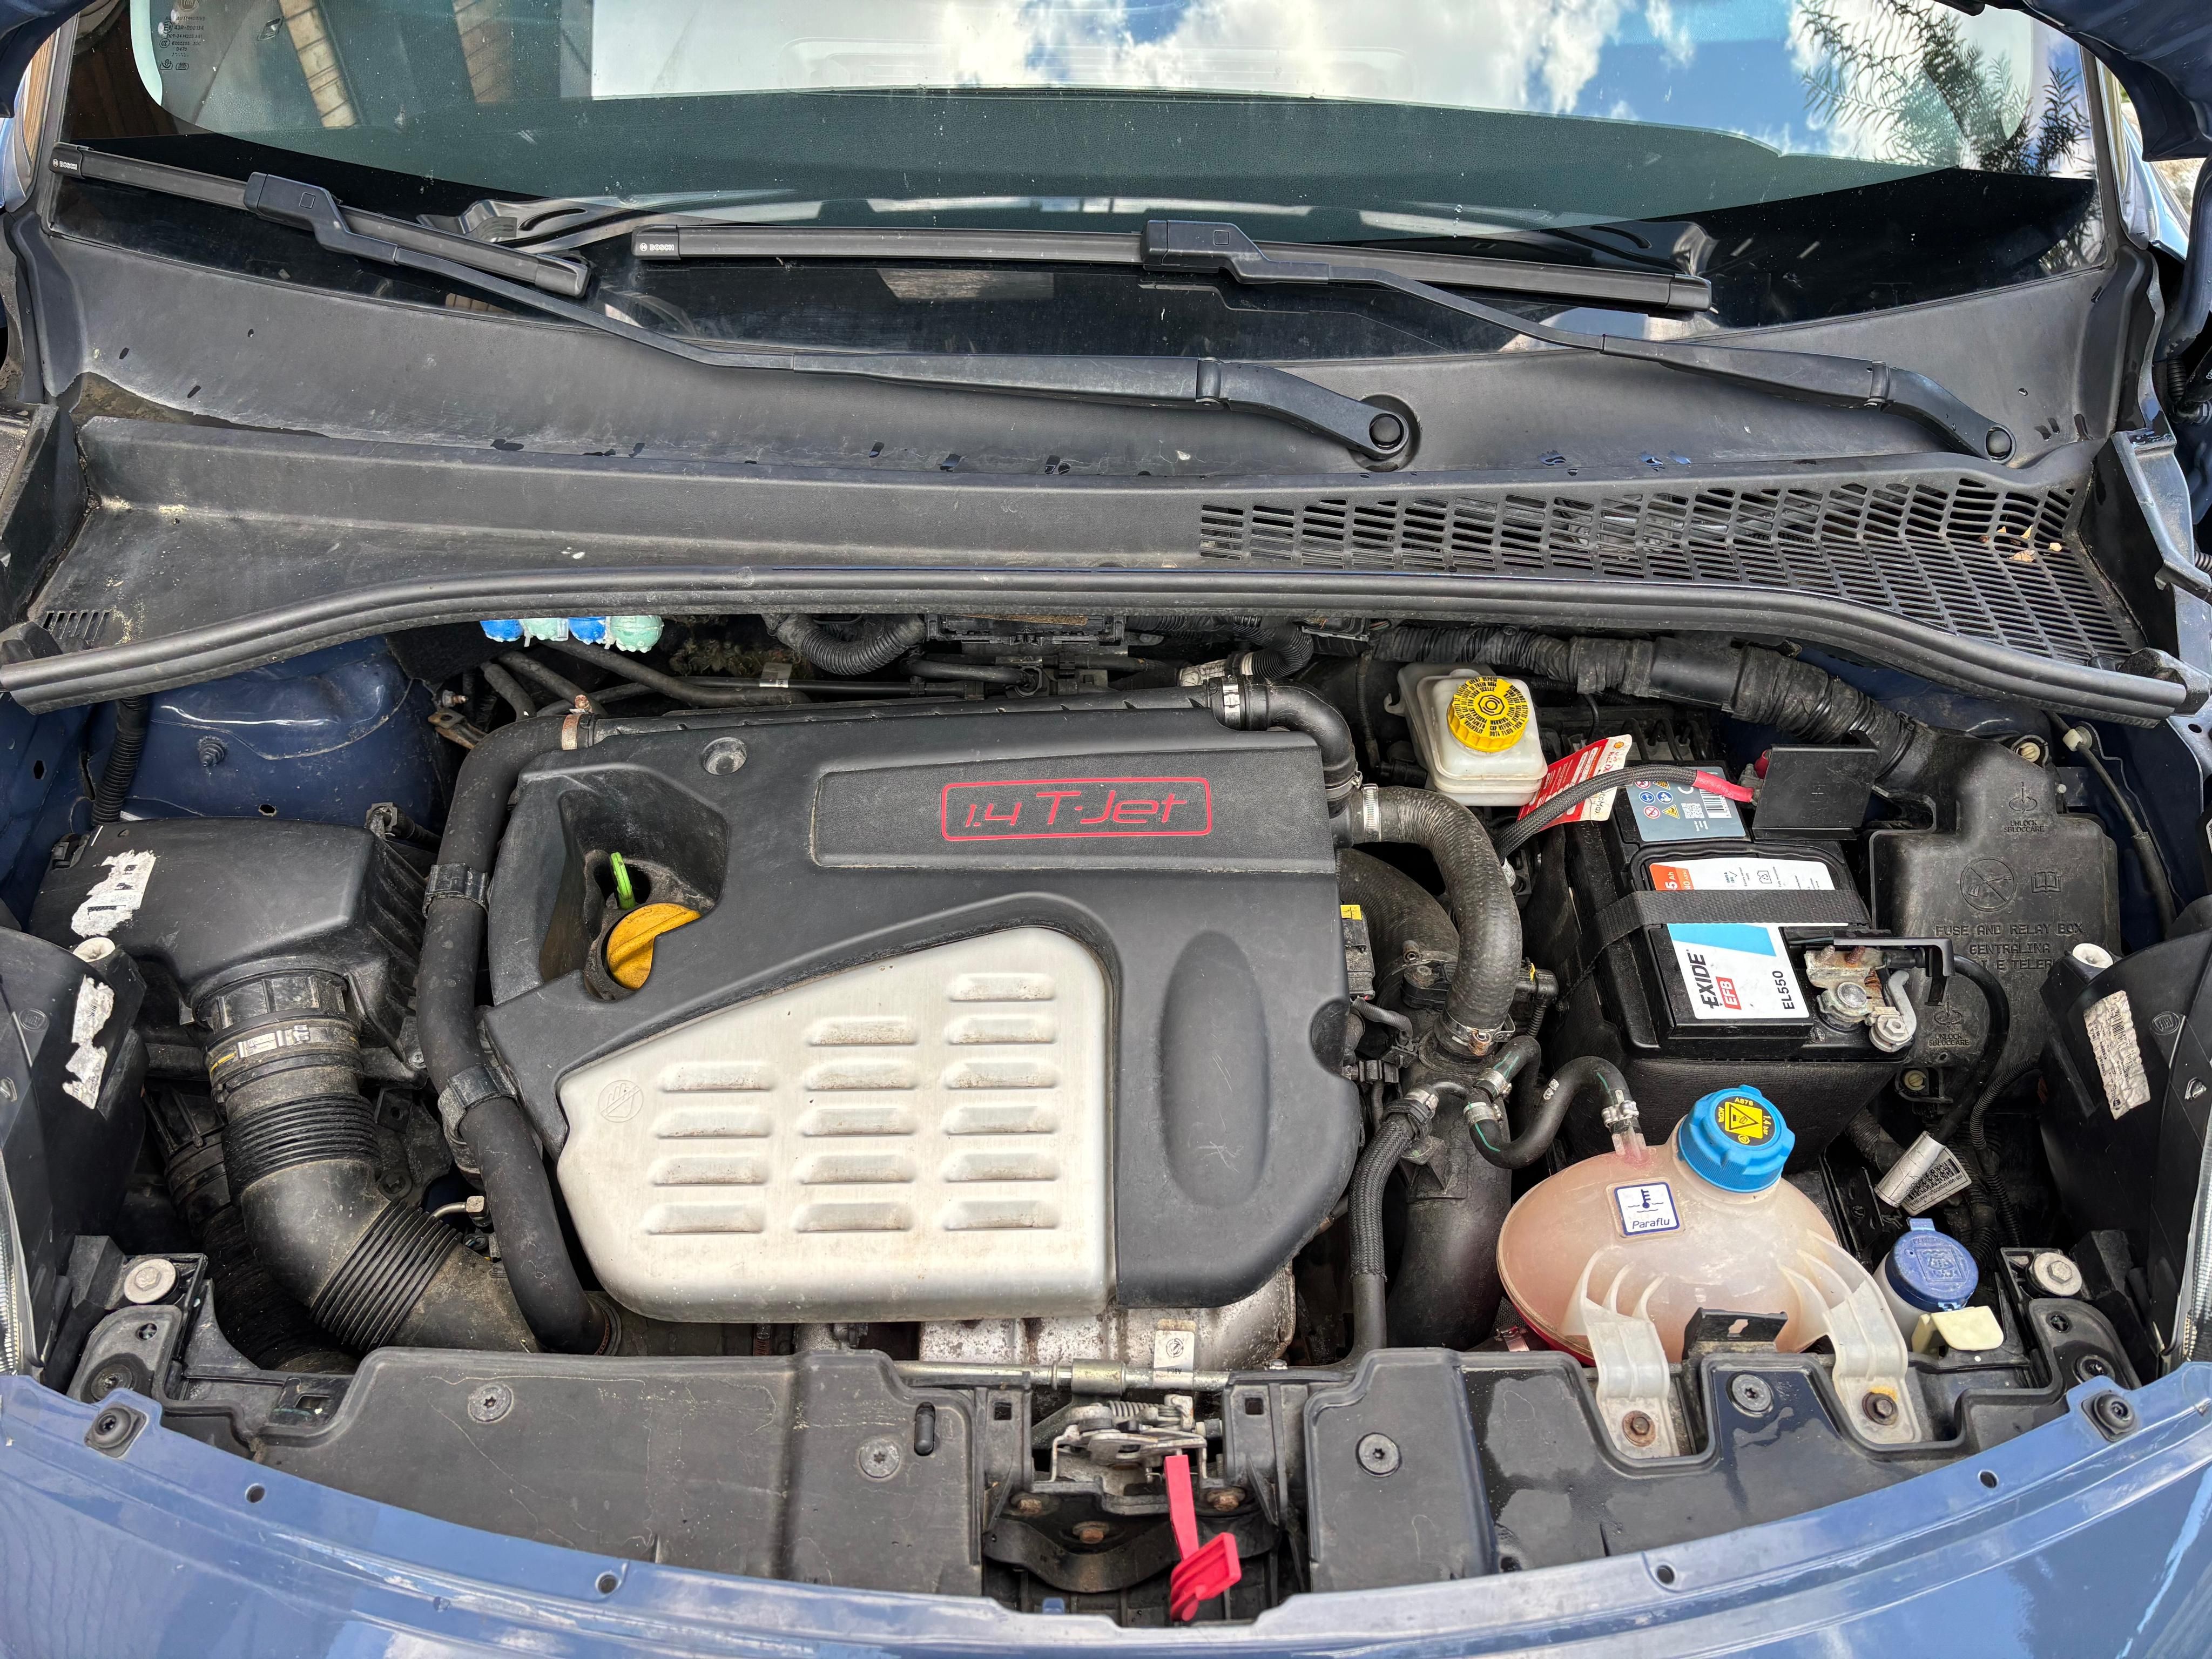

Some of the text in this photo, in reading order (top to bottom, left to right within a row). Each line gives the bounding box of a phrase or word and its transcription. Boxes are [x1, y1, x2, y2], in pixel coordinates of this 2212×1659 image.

[59, 161, 77, 170] BOSCH
[1507, 707, 1515, 717] CLEAN
[1499, 720, 1514, 730] BEFORE
[1513, 721, 1523, 730] FROM
[966, 802, 1022, 827] 1.4
[1665, 872, 1678, 891] 5 Ah
[1682, 881, 1691, 891] 40
[1936, 923, 2083, 936] FUSE AND RELAY BOX
[1970, 943, 2051, 960] CENTRALINA
[1687, 952, 1719, 1009] EXIDE
[1719, 980, 1737, 1005] EFB
[1772, 970, 1795, 1010] EL550
[1734, 1097, 1754, 1107] A878
[1762, 1115, 1772, 1125] 1.4
[1632, 1217, 1670, 1230] Paraflu
